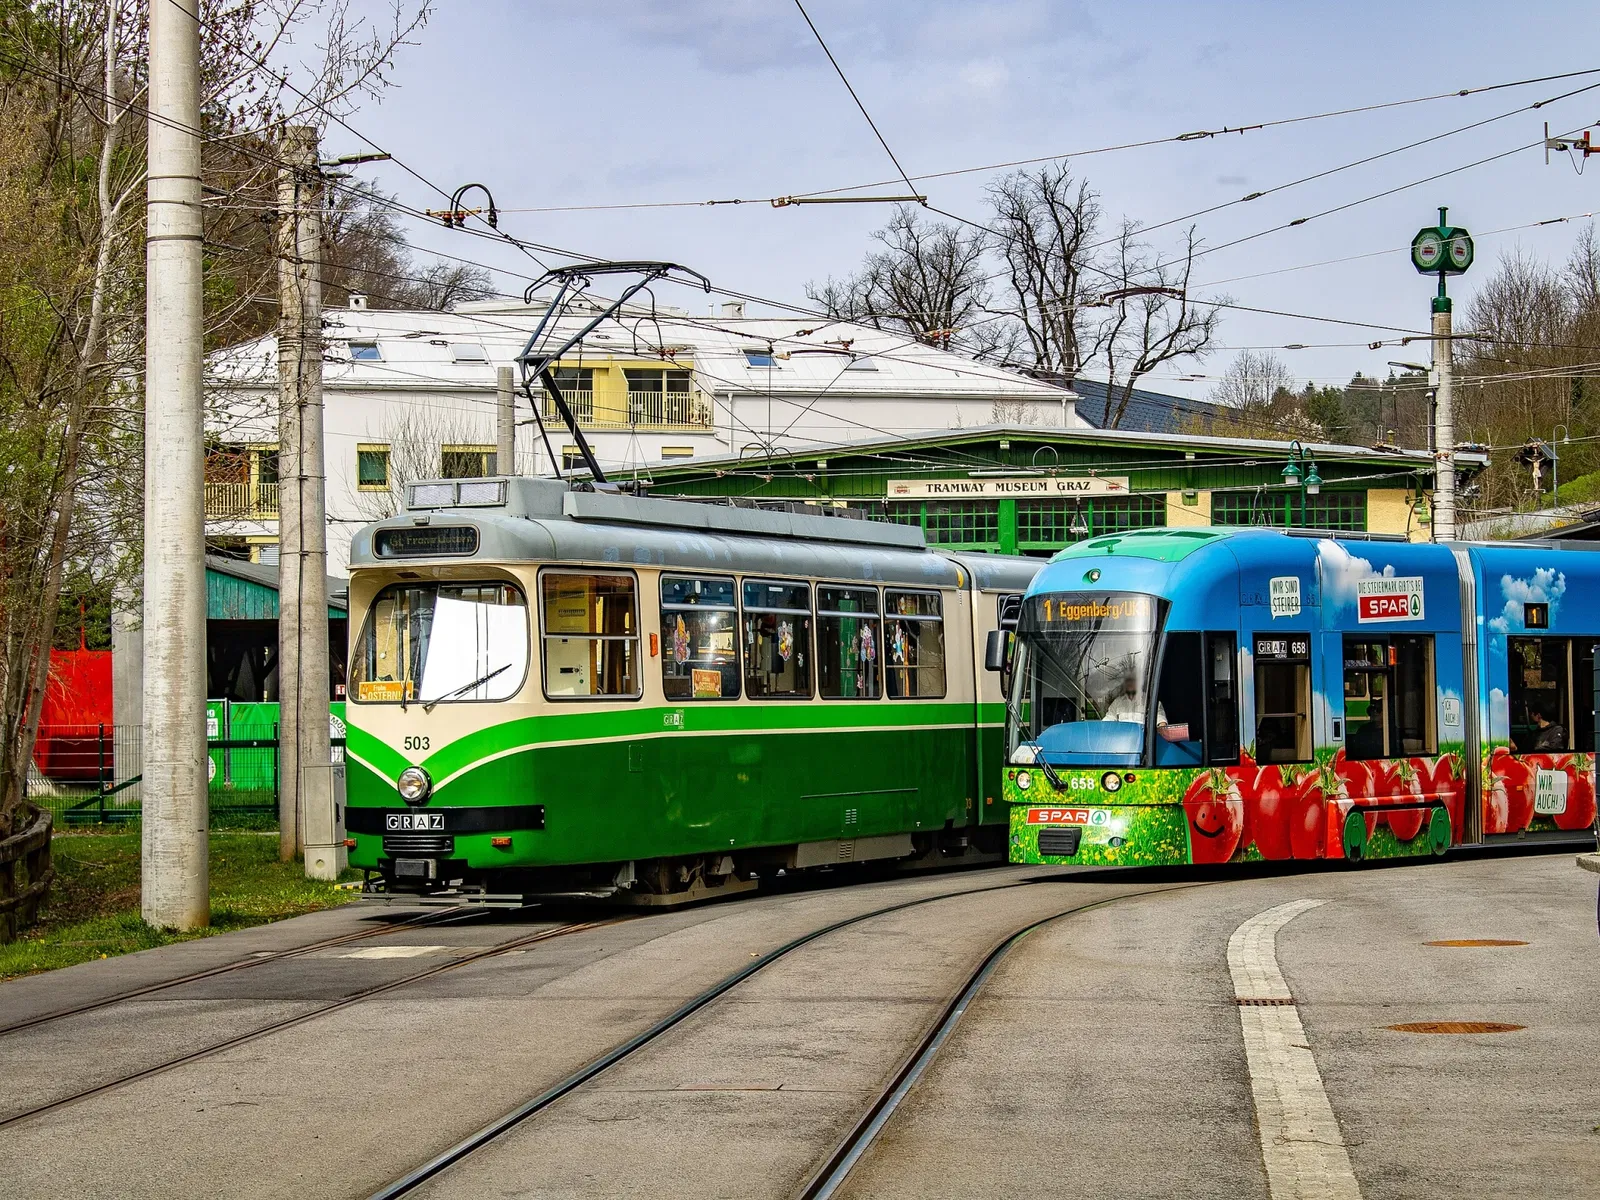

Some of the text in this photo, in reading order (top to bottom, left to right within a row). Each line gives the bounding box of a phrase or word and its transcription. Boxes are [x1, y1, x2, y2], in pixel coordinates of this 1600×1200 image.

[926, 481, 1091, 493] TRAMWAY MUSEUM GRAZ
[1271, 580, 1298, 594] WIR SIND
[1358, 582, 1366, 594] DIE
[1367, 581, 1398, 593] STEIERMARK
[1043, 599, 1052, 622] 1
[1272, 596, 1300, 612] STEIRER
[1369, 598, 1408, 615] SPAR
[1531, 608, 1538, 624] 1
[1258, 641, 1306, 654] GRAZ 658
[368, 691, 401, 701] OSTERN!
[663, 714, 684, 725] GRAZ
[404, 735, 430, 751] 503
[1071, 777, 1095, 790] 658
[1538, 774, 1553, 791] WIR
[1536, 793, 1559, 810] AUCH!
[386, 814, 444, 830] GRAZ
[1038, 810, 1088, 822] SPAR
